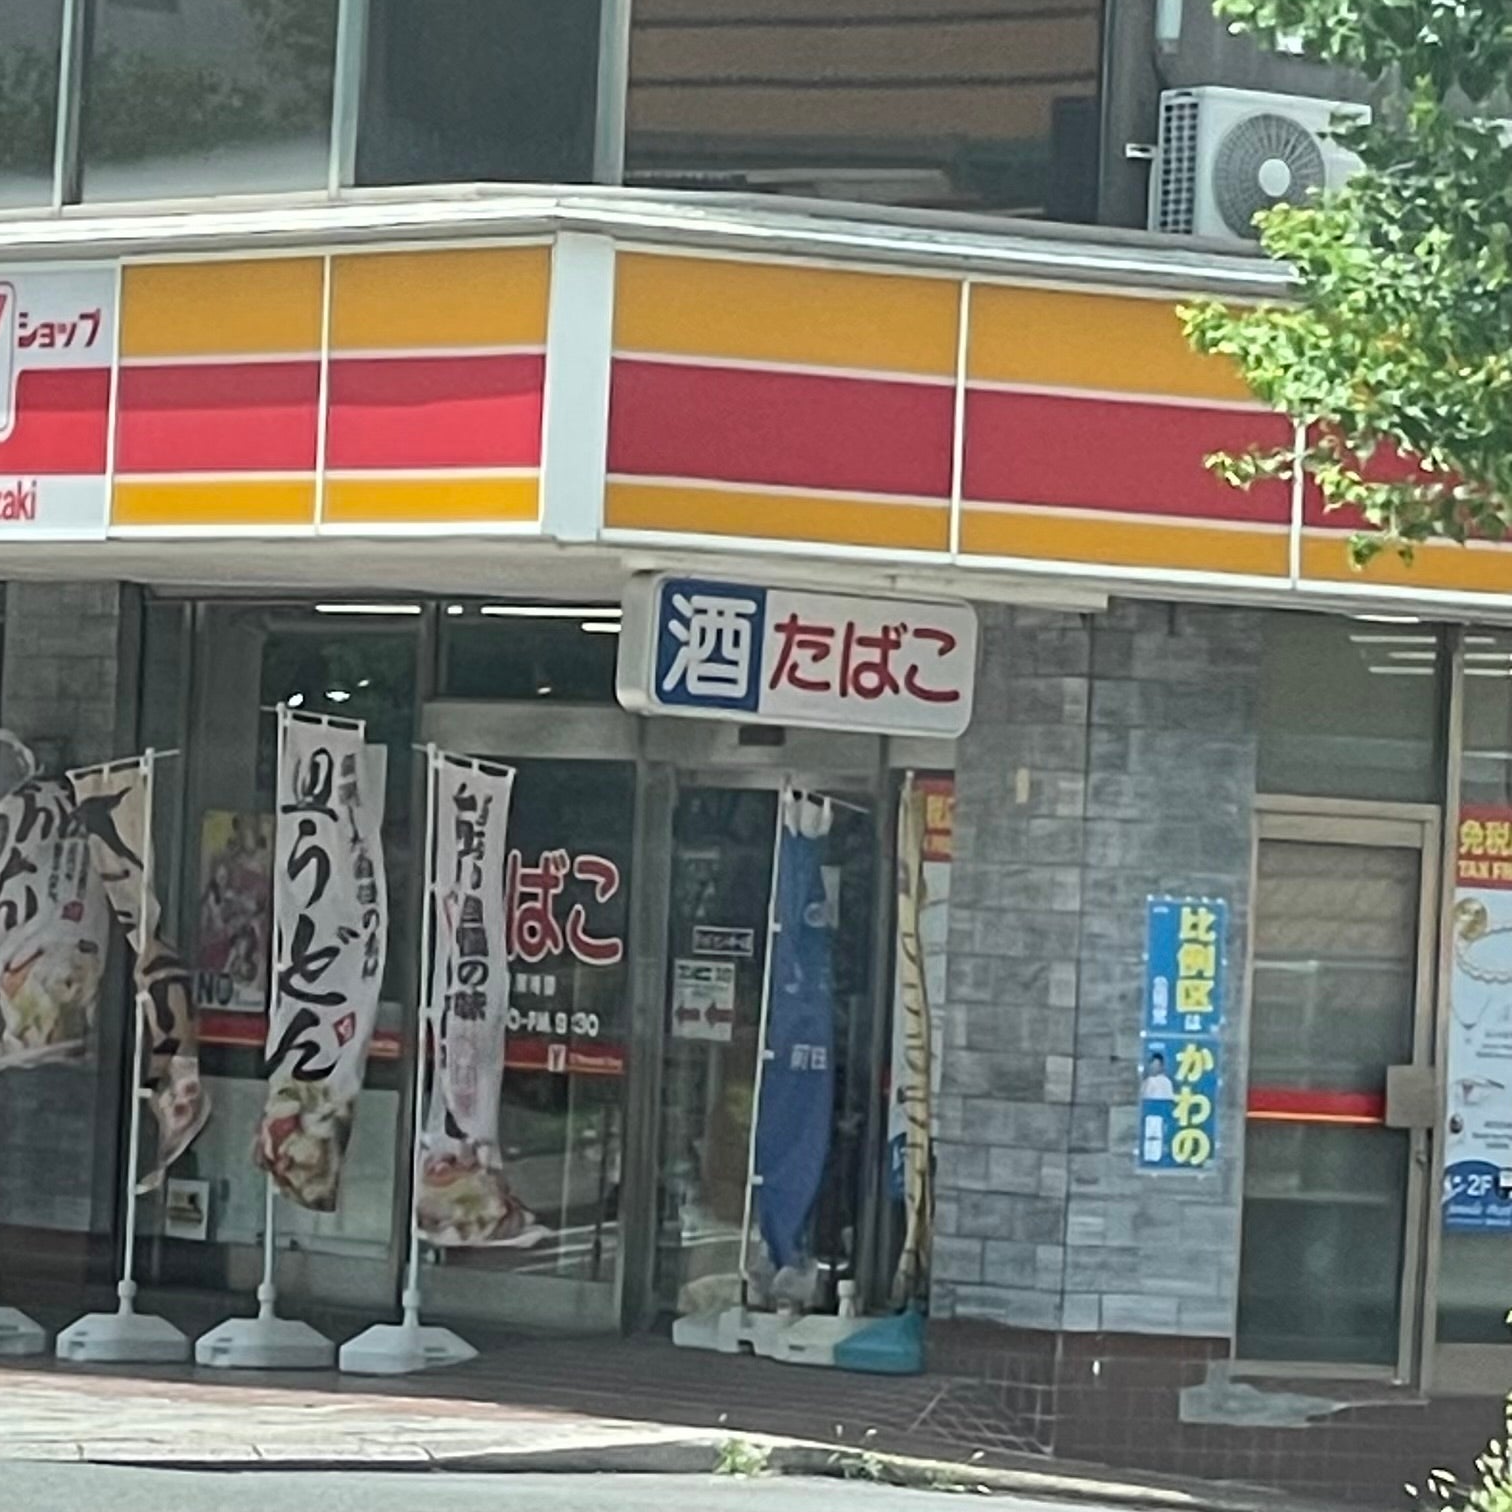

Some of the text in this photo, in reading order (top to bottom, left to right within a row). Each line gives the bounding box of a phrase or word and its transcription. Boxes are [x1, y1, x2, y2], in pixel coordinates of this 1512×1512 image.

[17, 308, 102, 349] ショップ
[662, 592, 961, 704] 酒 たばこ
[1172, 1043, 1214, 1165] かわの
